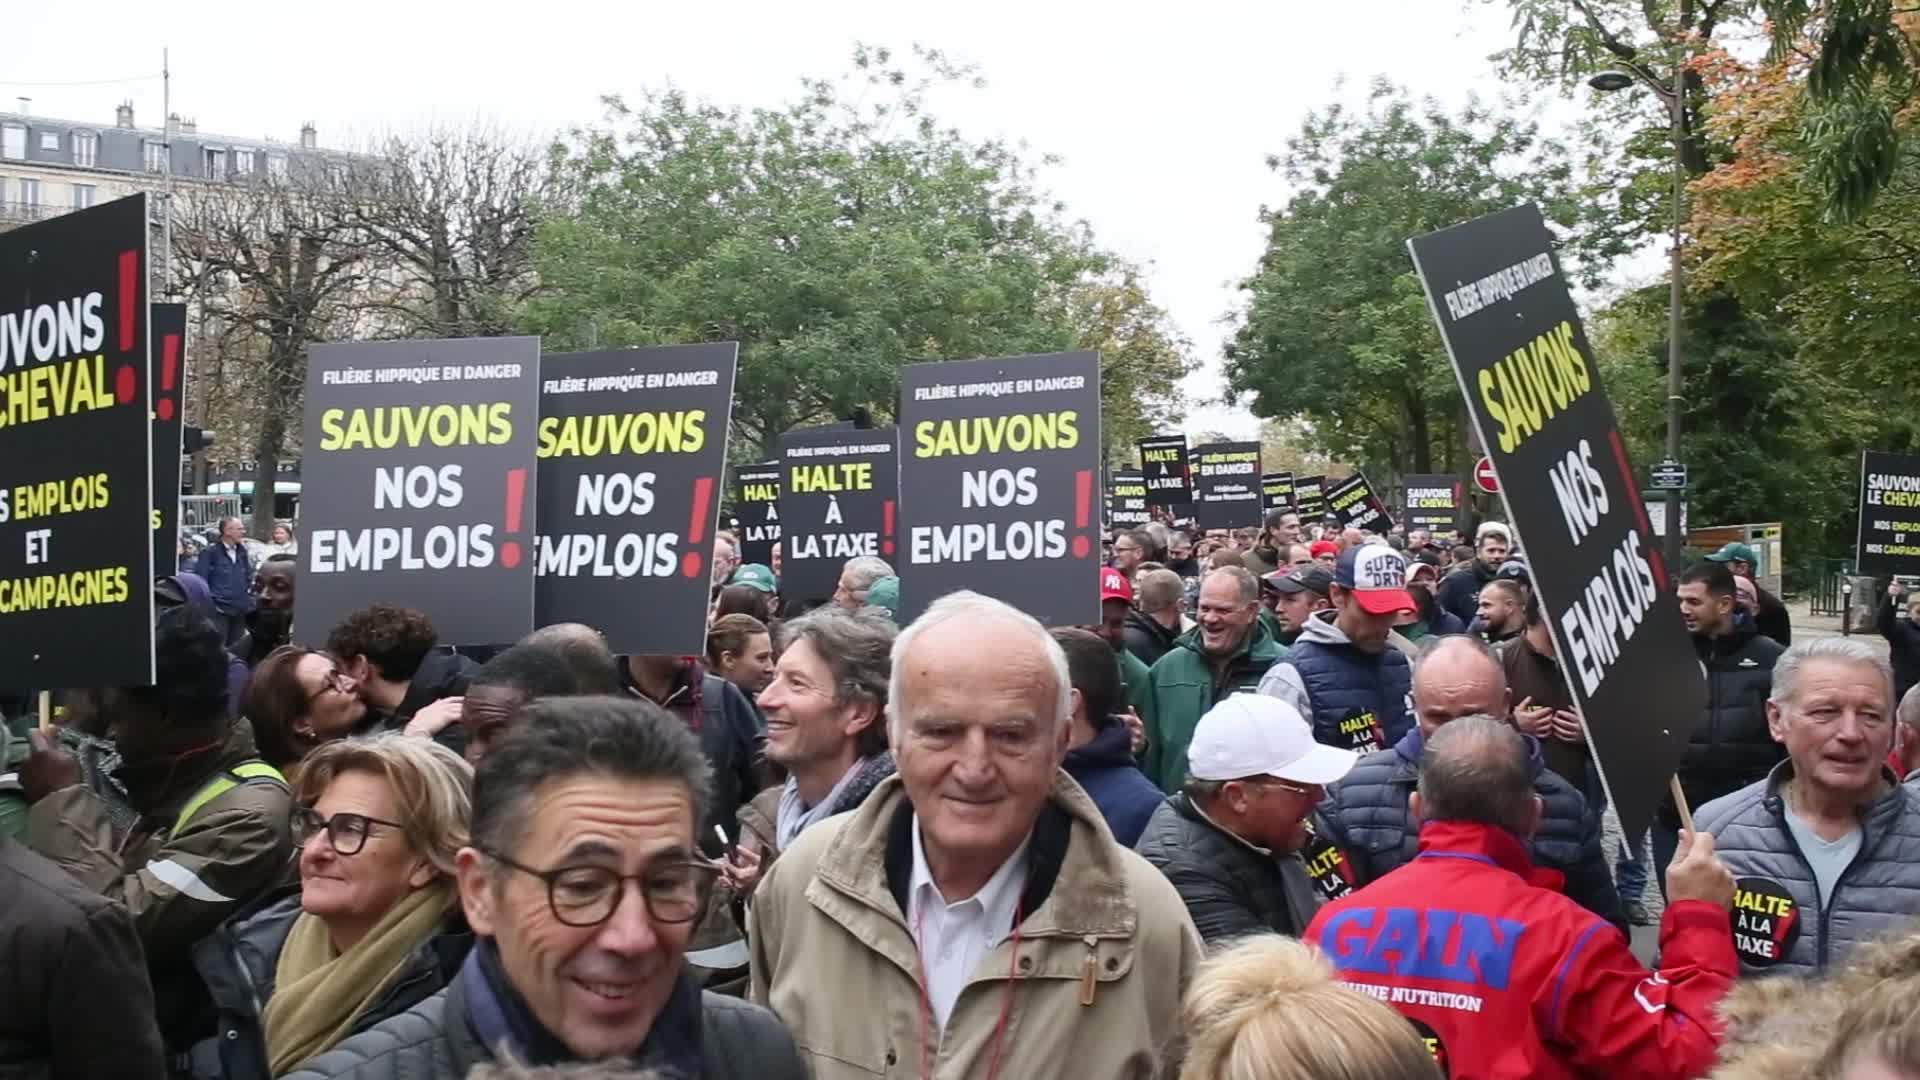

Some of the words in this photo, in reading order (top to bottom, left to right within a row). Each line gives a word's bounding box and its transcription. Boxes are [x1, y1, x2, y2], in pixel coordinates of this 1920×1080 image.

[1444, 280, 1484, 321] FILIÈRE
[1521, 252, 1554, 286] DANGER
[323, 367, 373, 385] FILIÈRE
[375, 368, 440, 384] HIPPIQUE
[443, 366, 461, 380] EN
[464, 364, 522, 380] DANGER
[543, 376, 587, 394] FILIÈRE
[588, 374, 645, 392] HIPPIQUE
[646, 374, 665, 388] EN
[665, 371, 718, 387] DANGER
[1478, 320, 1590, 454] SAUVONS
[915, 383, 957, 400] FILIÈRE
[959, 380, 1014, 398] HIPPIQUE
[1016, 379, 1033, 393] EN
[1035, 376, 1085, 391] DANGER
[320, 402, 512, 450] SAUVONS
[536, 410, 705, 458] SAUVONS
[915, 410, 1079, 458] SAUVONS
[1144, 449, 1178, 462] HALTE
[792, 463, 872, 492] HALTE
[1201, 465, 1214, 476] EN
[1215, 463, 1254, 475] DANGER
[374, 464, 463, 509] NOS
[575, 472, 656, 516] NOS
[962, 467, 1038, 508] NOS
[1115, 486, 1146, 496] SAUVO
[1147, 479, 1160, 489] LA
[1160, 477, 1183, 488] TAXE
[1407, 488, 1452, 498] SAUVONS
[1549, 439, 1608, 546] NOS
[1868, 474, 1920, 492] SAUVON
[15, 473, 109, 520] EMPLOIS
[825, 494, 843, 524] À
[1347, 501, 1366, 516] NOS
[1407, 498, 1418, 508] LE
[1419, 498, 1455, 508] CHEVAL
[1867, 490, 1881, 504] LE
[1883, 491, 1920, 507] CHEVA
[766, 502, 778, 520] À
[746, 527, 765, 541] LA
[1874, 520, 1890, 530] NOS
[25, 529, 52, 564] ET
[310, 523, 495, 573] EMPLOIS
[792, 535, 820, 559] LA
[822, 532, 879, 558] TAXE
[911, 519, 1067, 564] EMPLOIS
[1866, 544, 1882, 553] NOS
[1895, 534, 1905, 543] ET
[1561, 529, 1656, 698] EMPLOIS
[1340, 713, 1376, 734] HALTE
[1360, 730, 1373, 741] LA
[1304, 846, 1344, 878] ALTE
[1321, 873, 1344, 892] LA
[1738, 909, 1748, 929] À
[1751, 916, 1771, 934] LA
[1320, 906, 1526, 992] GAIN
[1735, 932, 1774, 958] TAXE
[1390, 987, 1483, 1013] NUTRITION
